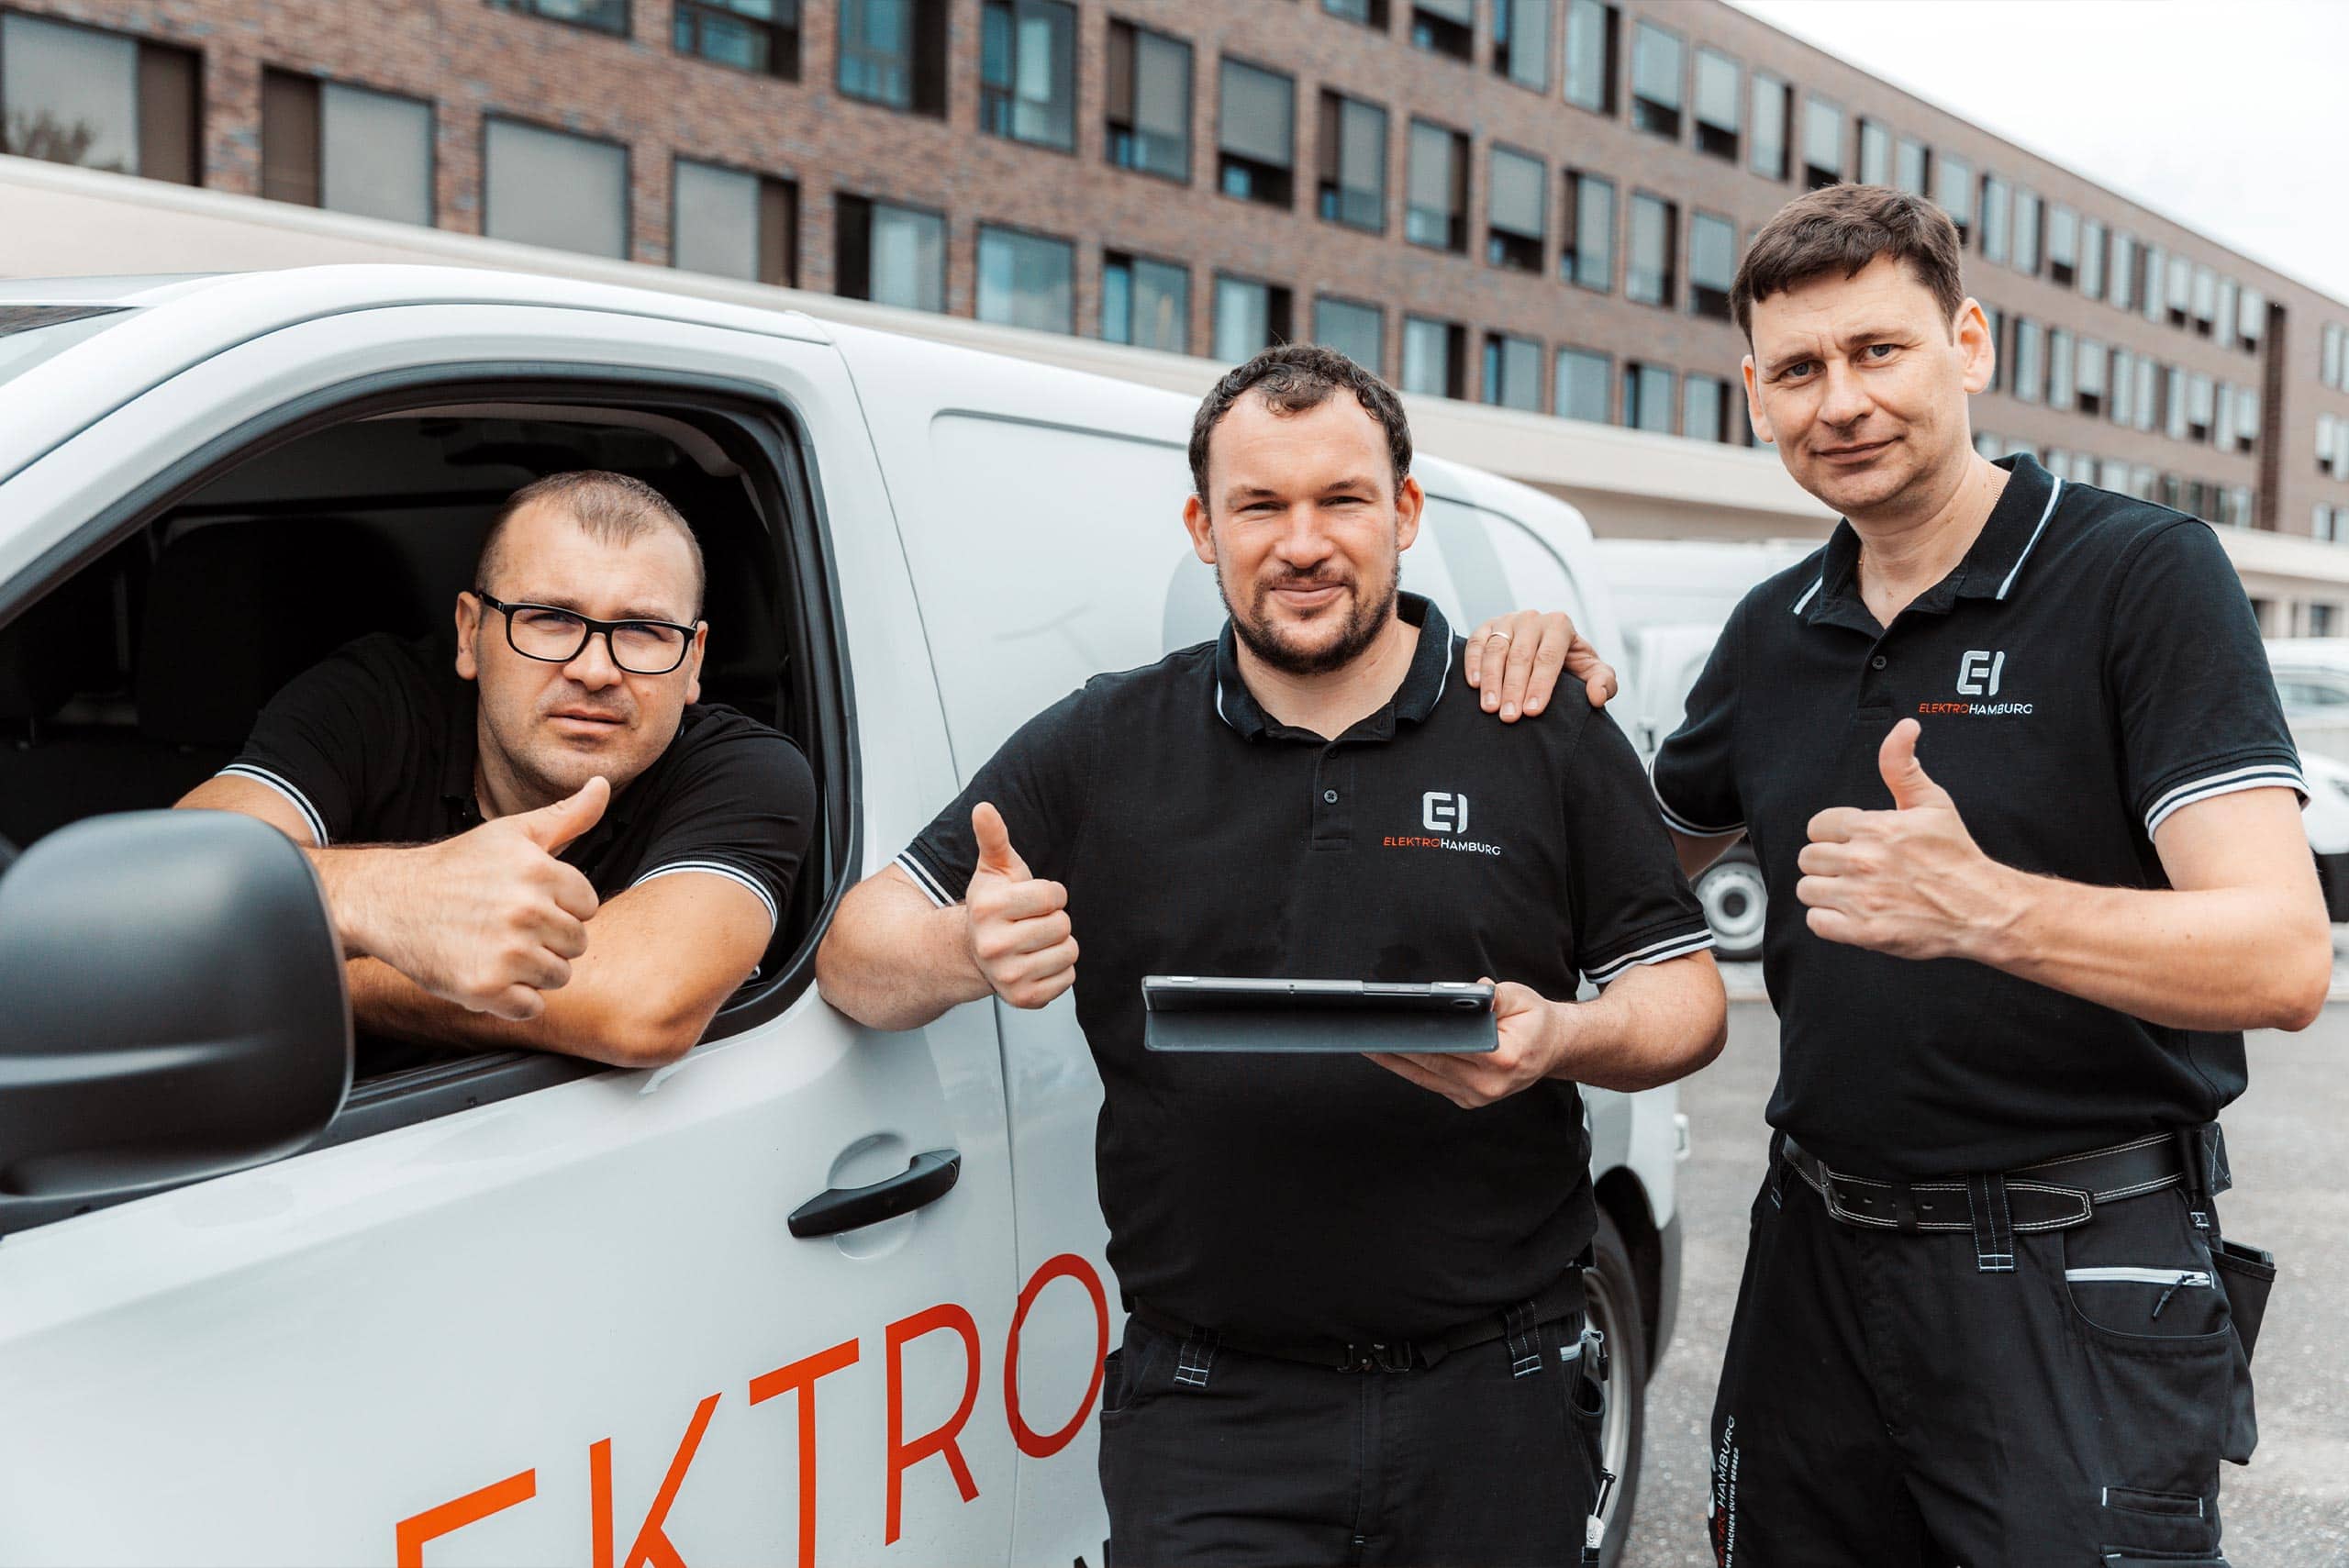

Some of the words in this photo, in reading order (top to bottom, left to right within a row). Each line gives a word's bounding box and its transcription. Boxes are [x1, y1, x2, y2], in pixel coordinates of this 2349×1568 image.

[1919, 703, 2032, 715] ELEKTROHAMBURG
[1383, 836, 1501, 856] ELEKTROHAMBURG
[396, 1253, 1109, 1568] KTRO
[1728, 1514, 1736, 1551] MACHEN
